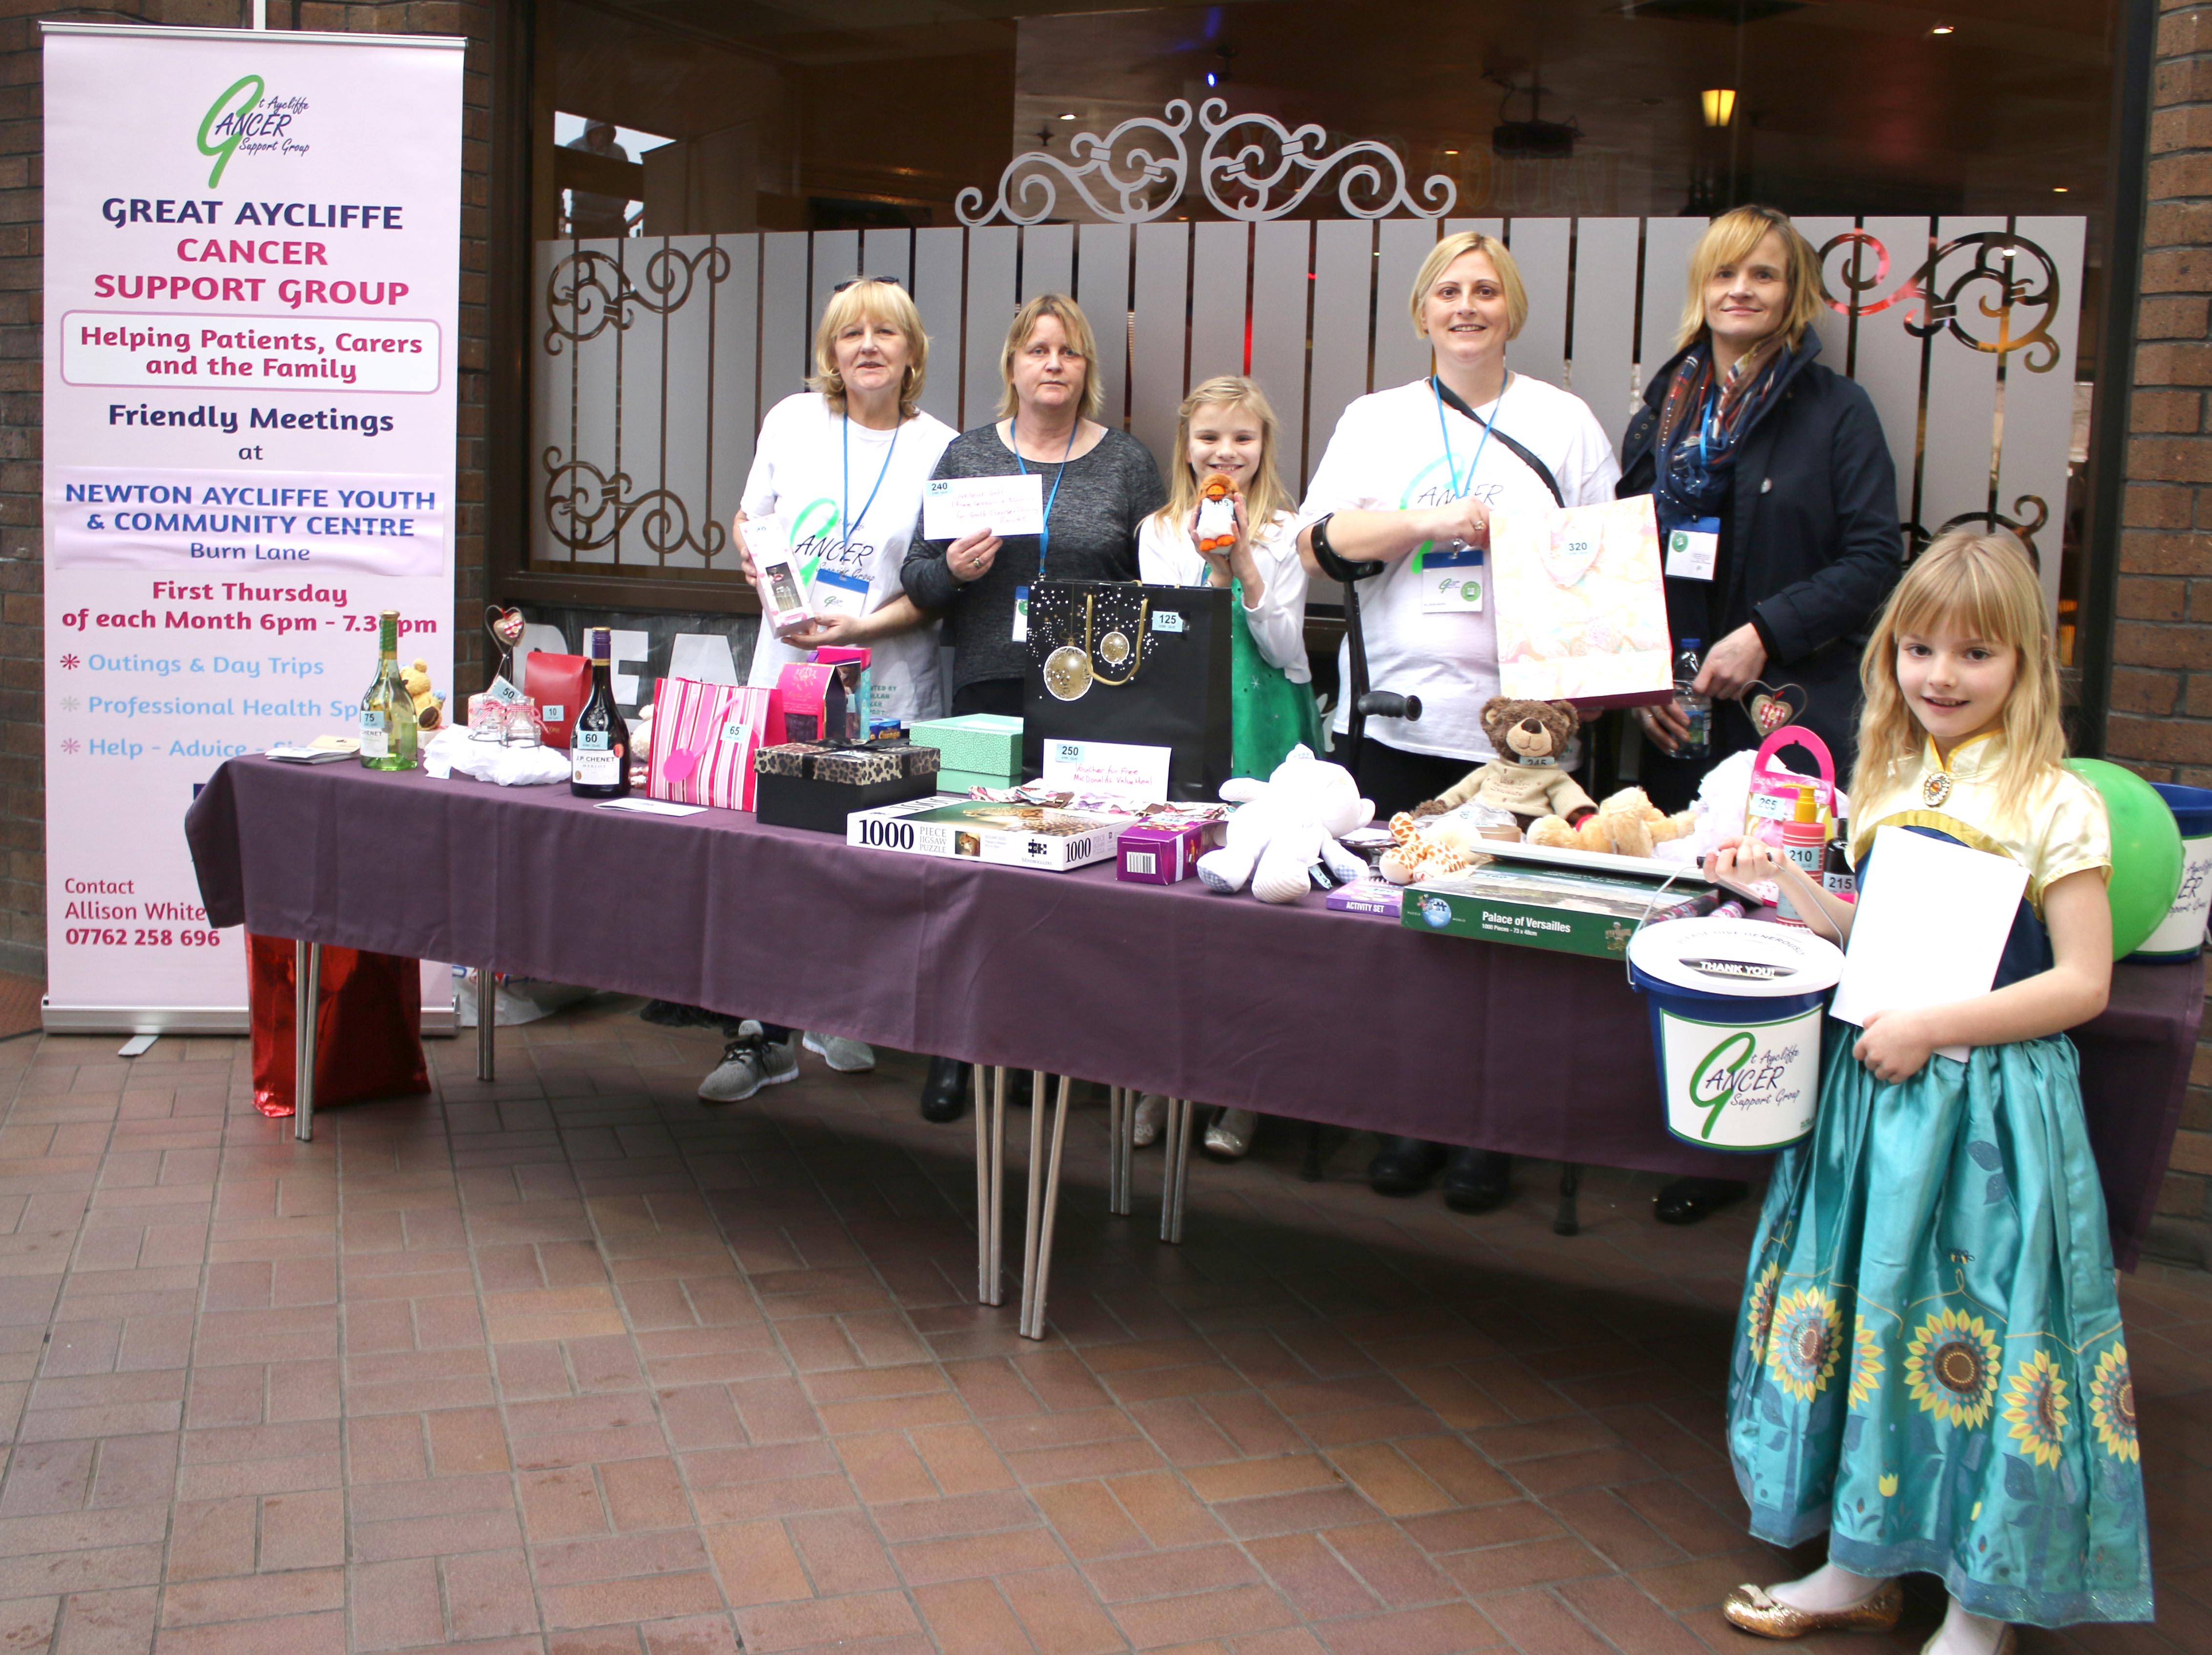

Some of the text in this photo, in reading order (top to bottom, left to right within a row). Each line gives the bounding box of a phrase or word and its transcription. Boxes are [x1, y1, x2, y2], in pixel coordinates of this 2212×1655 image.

[268, 96, 310, 115] Aycliffe
[239, 137, 310, 157] Support Group
[103, 198, 403, 230] GREAT AYCLIFFE
[177, 238, 328, 266] CANCER
[94, 274, 409, 309] SUPPORT GROUP
[81, 326, 422, 355] Helping Patients, Carers
[146, 357, 357, 383] and the Family
[109, 404, 394, 436] Friendly Meetings
[238, 445, 263, 461] at
[932, 482, 947, 491] 240
[65, 484, 436, 510] NEWTON AYCLIFFE YOUTH
[87, 512, 415, 537] & COMMUNITY CENTRE
[190, 543, 310, 561] Burn Lane
[1569, 542, 1587, 551] 320
[153, 582, 347, 606] First Thursday
[62, 608, 89, 631] of
[96, 610, 156, 628] each
[165, 612, 251, 630] Month
[260, 613, 316, 635] 6pm
[343, 616, 438, 637] 7.3pm
[1160, 615, 1176, 624] 125
[88, 654, 325, 679] Outings & Day Trips
[503, 688, 515, 699] 50
[88, 696, 358, 721] Professional Health Sp
[585, 734, 597, 743] 60
[730, 725, 739, 736] 65
[89, 740, 143, 759] Help
[169, 740, 246, 757] Advice
[1062, 746, 1078, 756] 250
[1076, 763, 1104, 773] Voucher
[1758, 798, 1778, 810] 265
[858, 819, 914, 850] 1000
[920, 827, 946, 837] PIECE
[920, 836, 946, 845] JIGSAW
[920, 844, 946, 853] PUZZLE
[1066, 838, 1091, 863] 1000
[1790, 850, 1812, 862] 210
[64, 878, 134, 895] Contact
[1829, 877, 1852, 889] 215
[65, 901, 207, 922] Allison White
[1346, 902, 1372, 912] ACTIVITY
[1482, 911, 1571, 933] Palace of Versailles
[65, 929, 221, 947] 07762 258 696
[1745, 932, 1806, 956] GENEROUSLY
[1700, 961, 1775, 976] THANK YOU!
[1760, 1044, 1799, 1068] Aycliffe
[1731, 1088, 1800, 1111] Support Group
